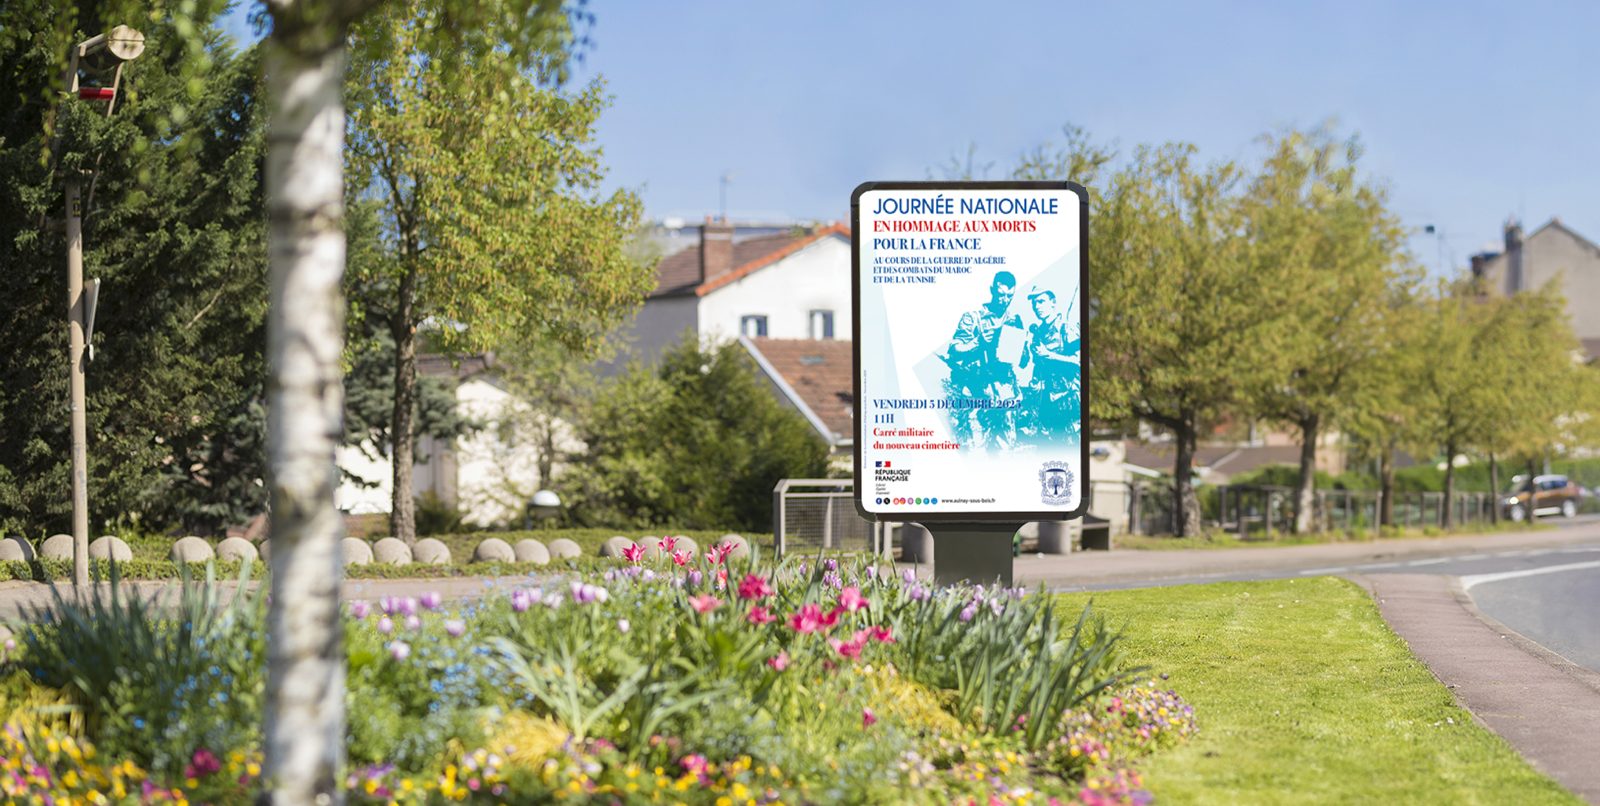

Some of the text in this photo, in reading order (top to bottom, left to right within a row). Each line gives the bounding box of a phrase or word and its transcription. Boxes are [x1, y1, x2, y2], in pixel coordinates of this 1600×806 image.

[874, 194, 1058, 214] JOURNÉE NATIONALE
[874, 220, 1036, 232] EN HOMMAGE AUX MORTS
[874, 238, 981, 250] POUR LA FRANCE
[874, 400, 927, 409] VENDREDI
[929, 400, 934, 409] 5
[874, 414, 894, 423] 11H
[873, 428, 934, 436] Carré militaire
[873, 441, 884, 450] du
[922, 441, 960, 450] cimetière
